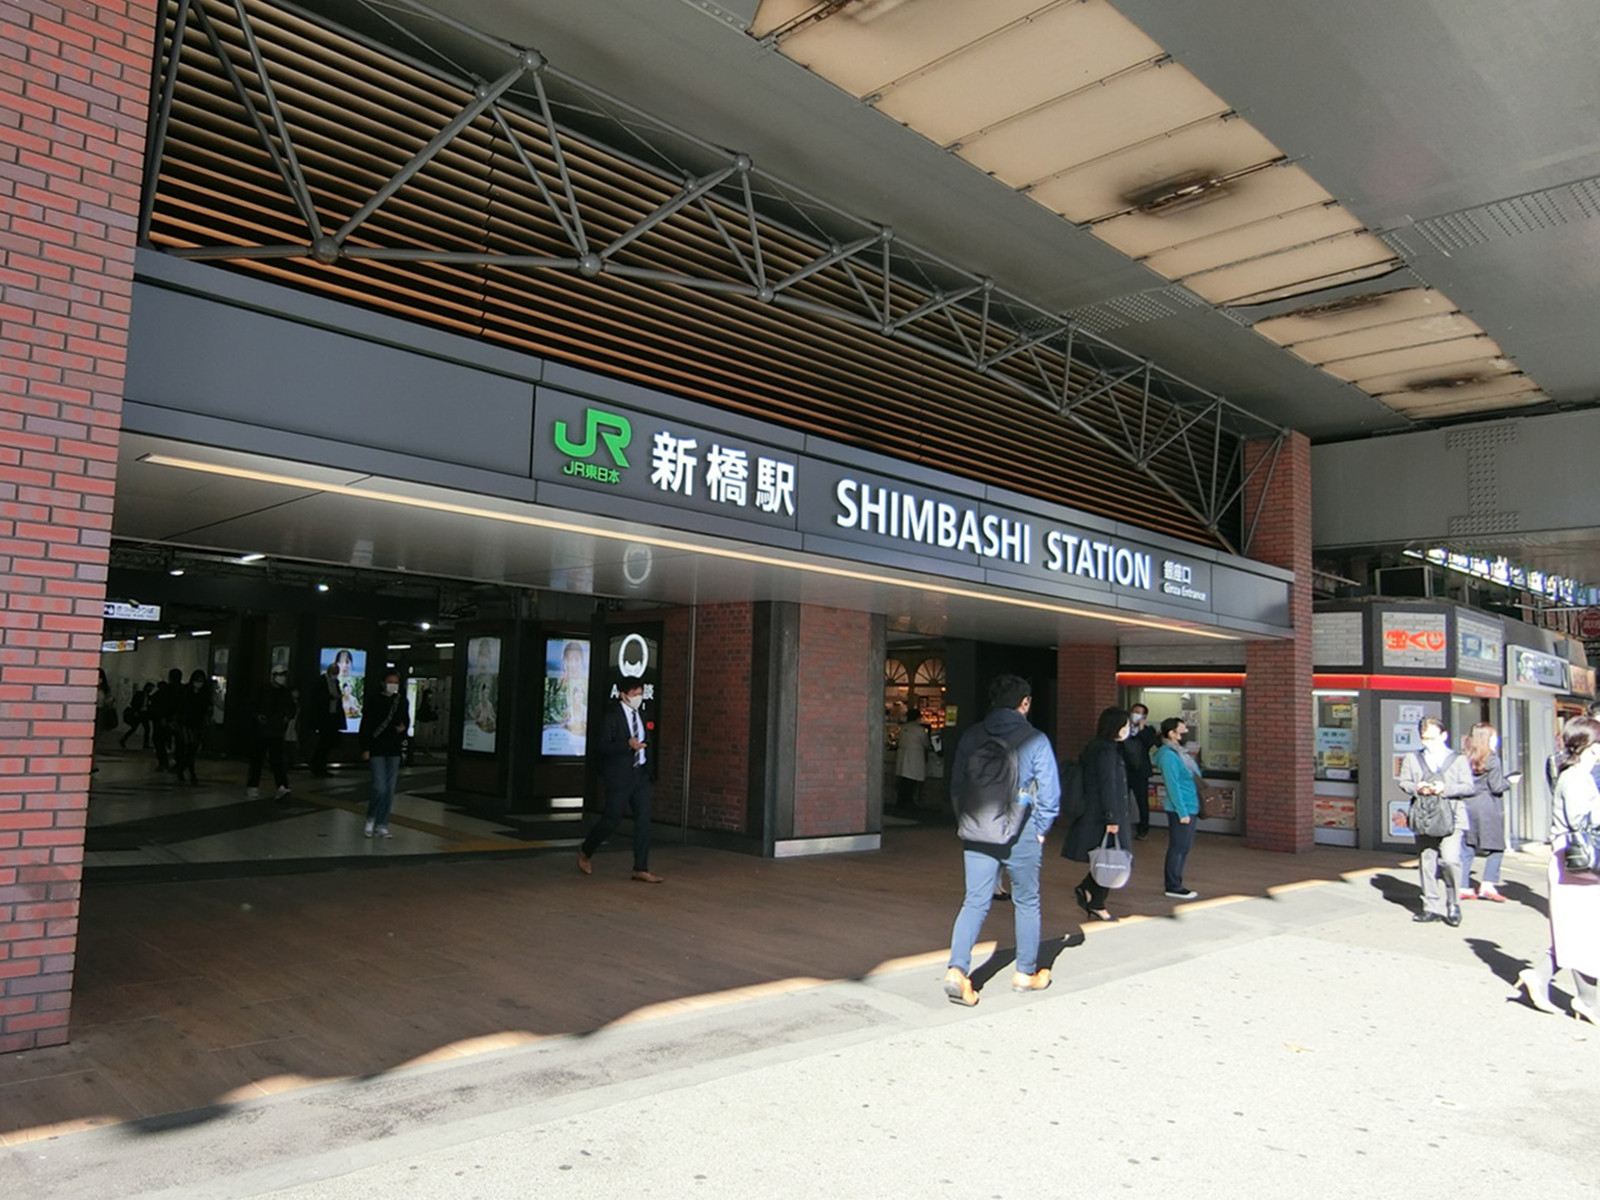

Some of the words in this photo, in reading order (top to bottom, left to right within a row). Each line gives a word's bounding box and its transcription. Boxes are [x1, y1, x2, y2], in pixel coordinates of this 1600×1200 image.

[554, 408, 631, 467] JR
[563, 461, 620, 484] JR東日本
[650, 431, 795, 516] 新橋駅
[835, 478, 1031, 565] SHIMBASHI
[1046, 530, 1153, 590] STATION
